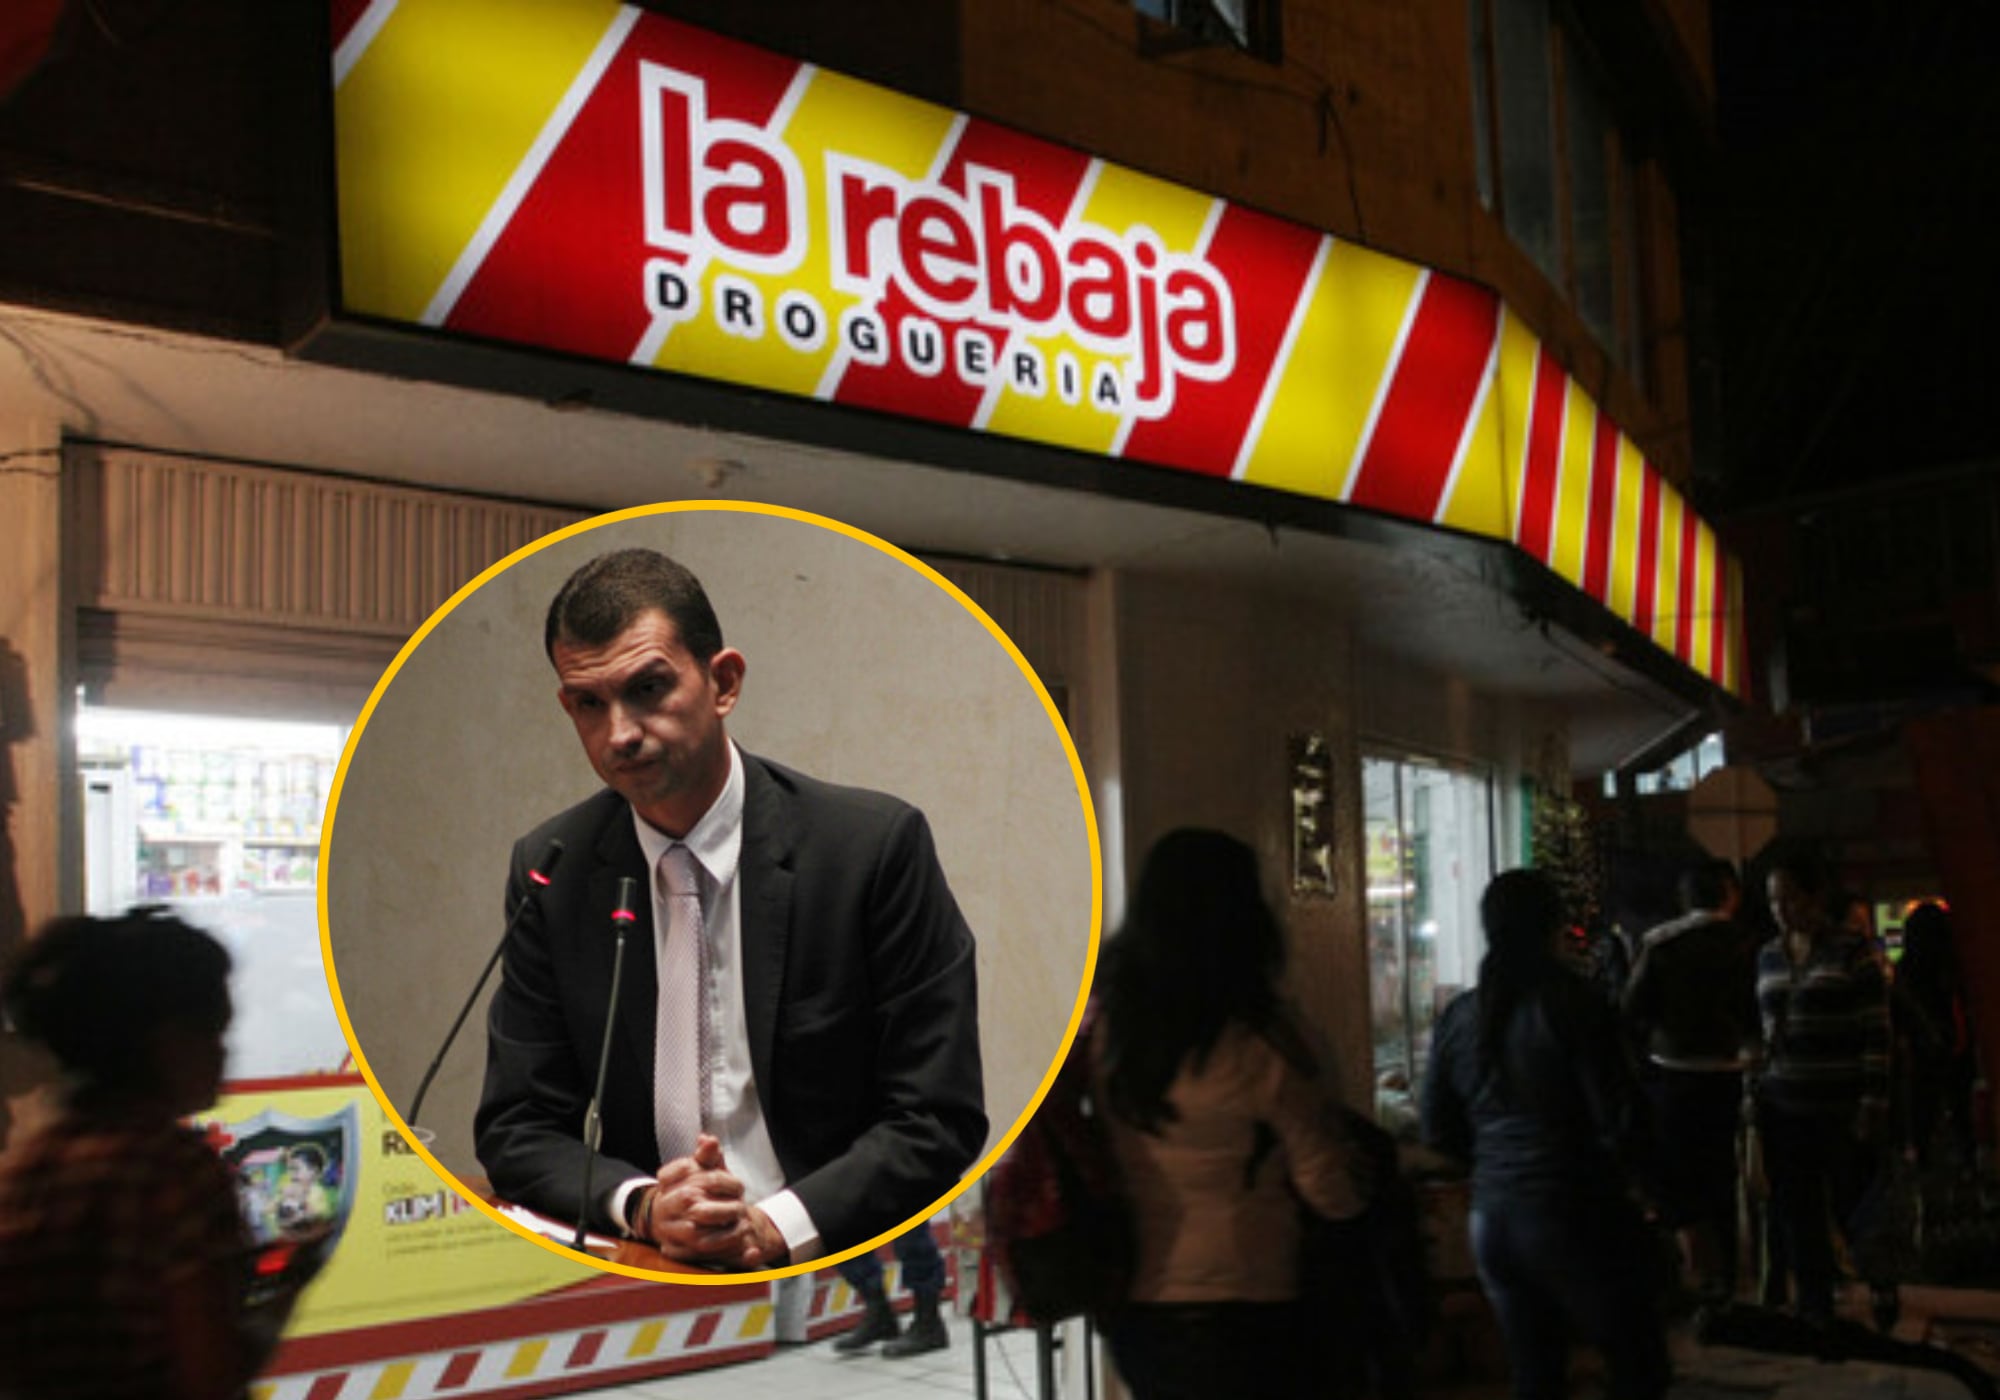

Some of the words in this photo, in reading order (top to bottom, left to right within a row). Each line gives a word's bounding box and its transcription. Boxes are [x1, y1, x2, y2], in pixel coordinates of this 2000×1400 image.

[658, 272, 1121, 405] DROGUERIA
[659, 84, 791, 259] la
[841, 172, 1225, 402] rebaja
